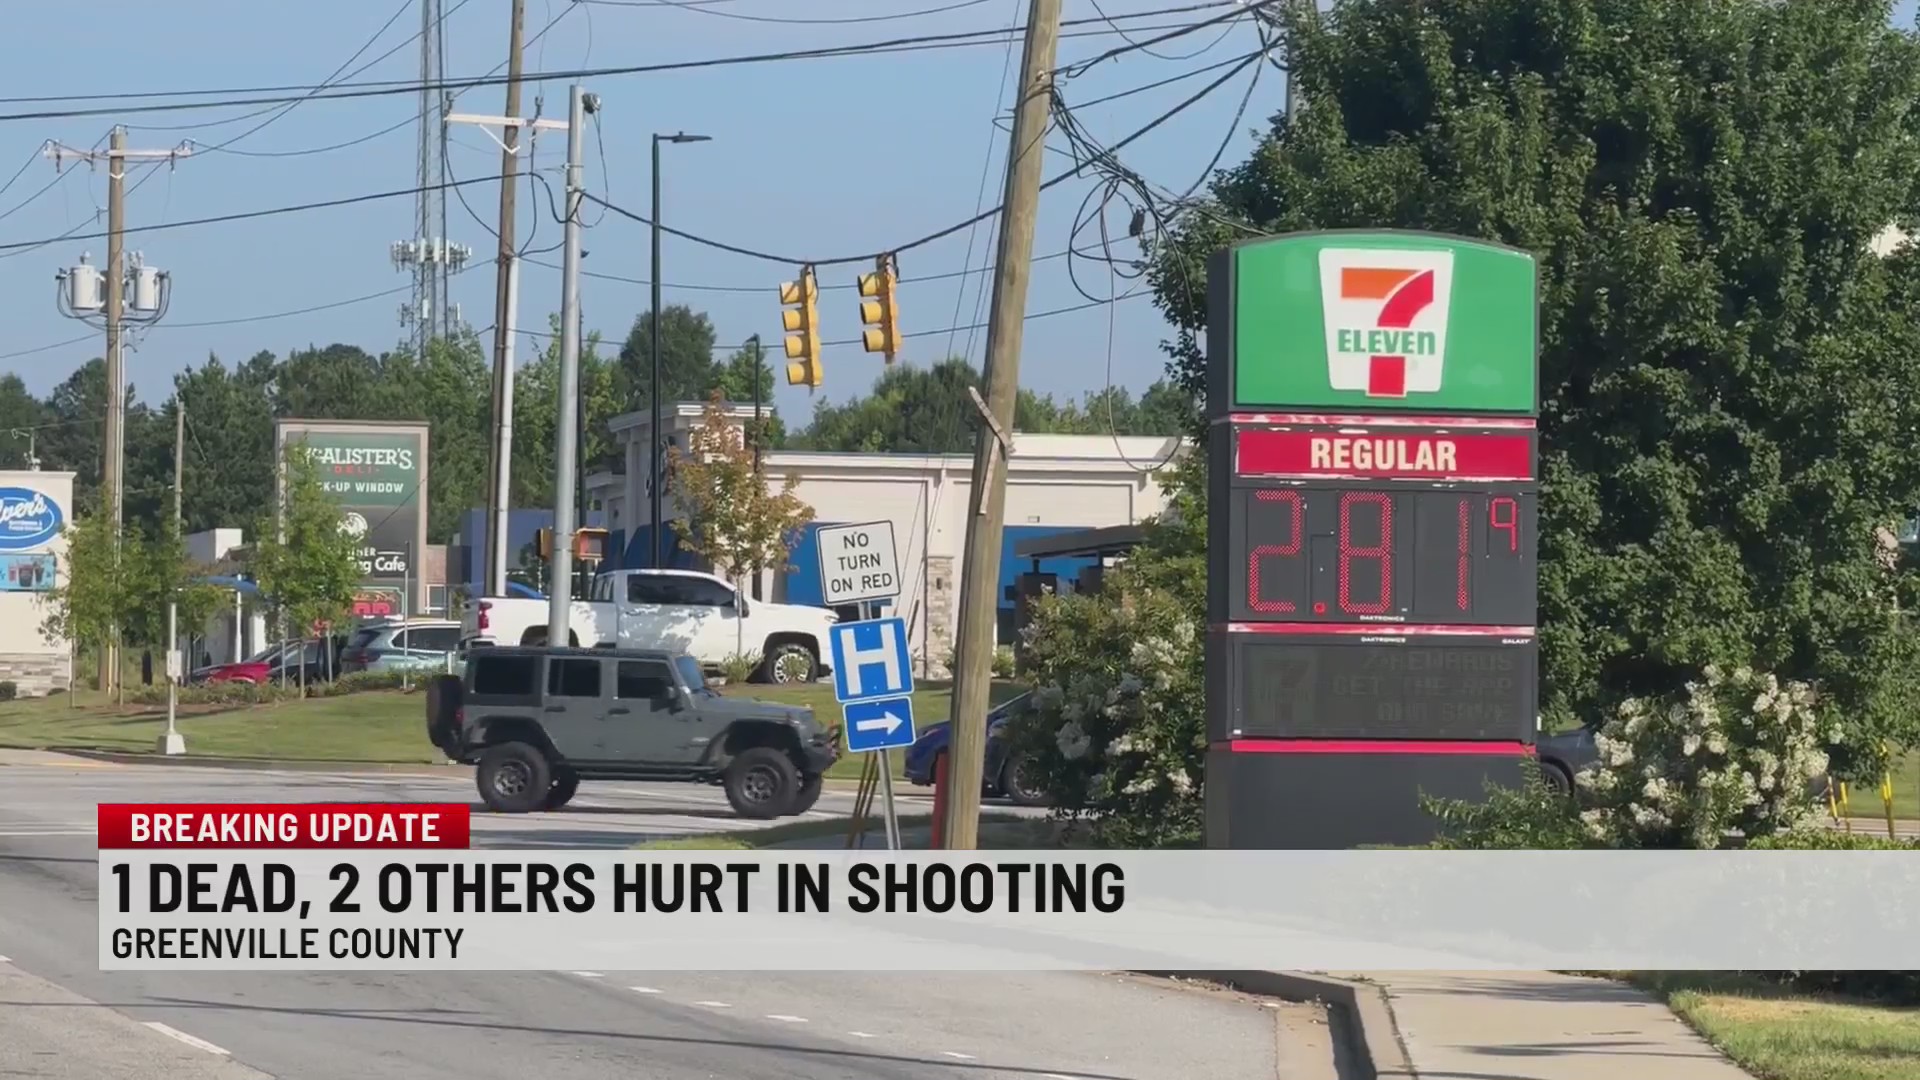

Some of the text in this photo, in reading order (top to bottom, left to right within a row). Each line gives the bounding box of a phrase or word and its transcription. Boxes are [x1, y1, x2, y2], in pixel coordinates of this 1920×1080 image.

[1341, 267, 1434, 395] 7
[1311, 438, 1457, 471] REGULAR
[334, 465, 371, 475] DELI
[355, 482, 404, 494] WINDOW
[843, 532, 869, 549] NO
[375, 556, 405, 571] Cafe
[837, 552, 881, 571] TURN
[831, 573, 892, 593] ON RED
[840, 624, 902, 696] H
